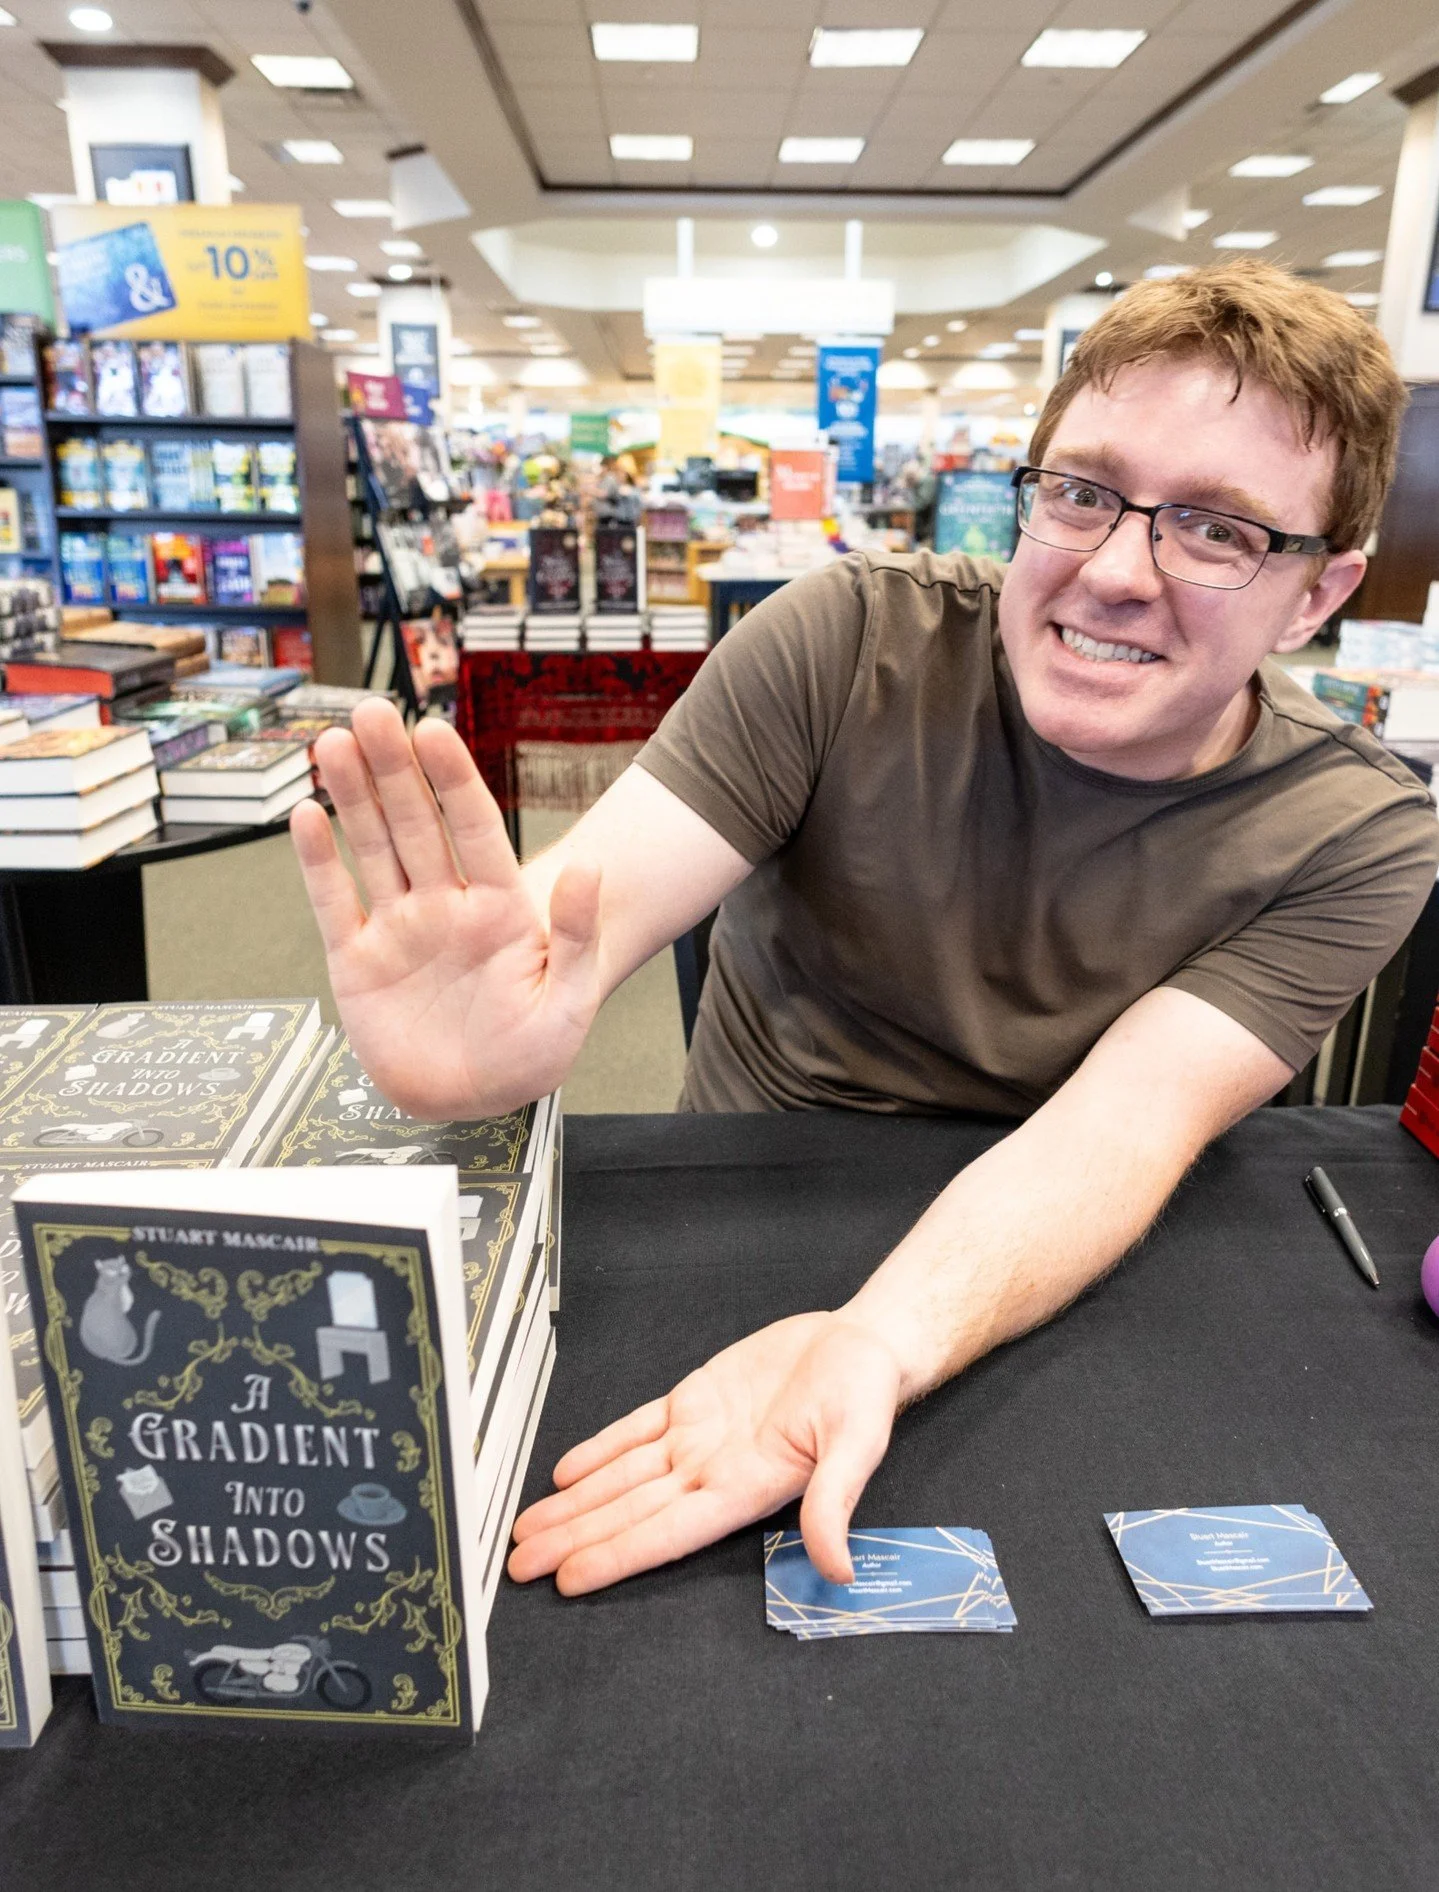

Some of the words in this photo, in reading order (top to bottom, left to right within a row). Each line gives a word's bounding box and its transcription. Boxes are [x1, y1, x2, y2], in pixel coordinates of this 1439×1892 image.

[91, 1049, 246, 1065] GRADIENT
[131, 1068, 181, 1081] INTO
[58, 1080, 221, 1096] SHADOWS
[22, 1162, 82, 1170] STUART
[88, 1160, 149, 1168] MASCAIR
[132, 1225, 217, 1247] STUART
[222, 1230, 320, 1253] MASCAIR
[230, 1374, 273, 1413] A
[128, 1412, 381, 1469] GRADIENT
[224, 1481, 305, 1518] INTO
[1190, 1533, 1215, 1541] Stuart
[147, 1519, 391, 1574] SHADOWS
[850, 1553, 865, 1562] uart
[867, 1553, 901, 1561] Mascair
